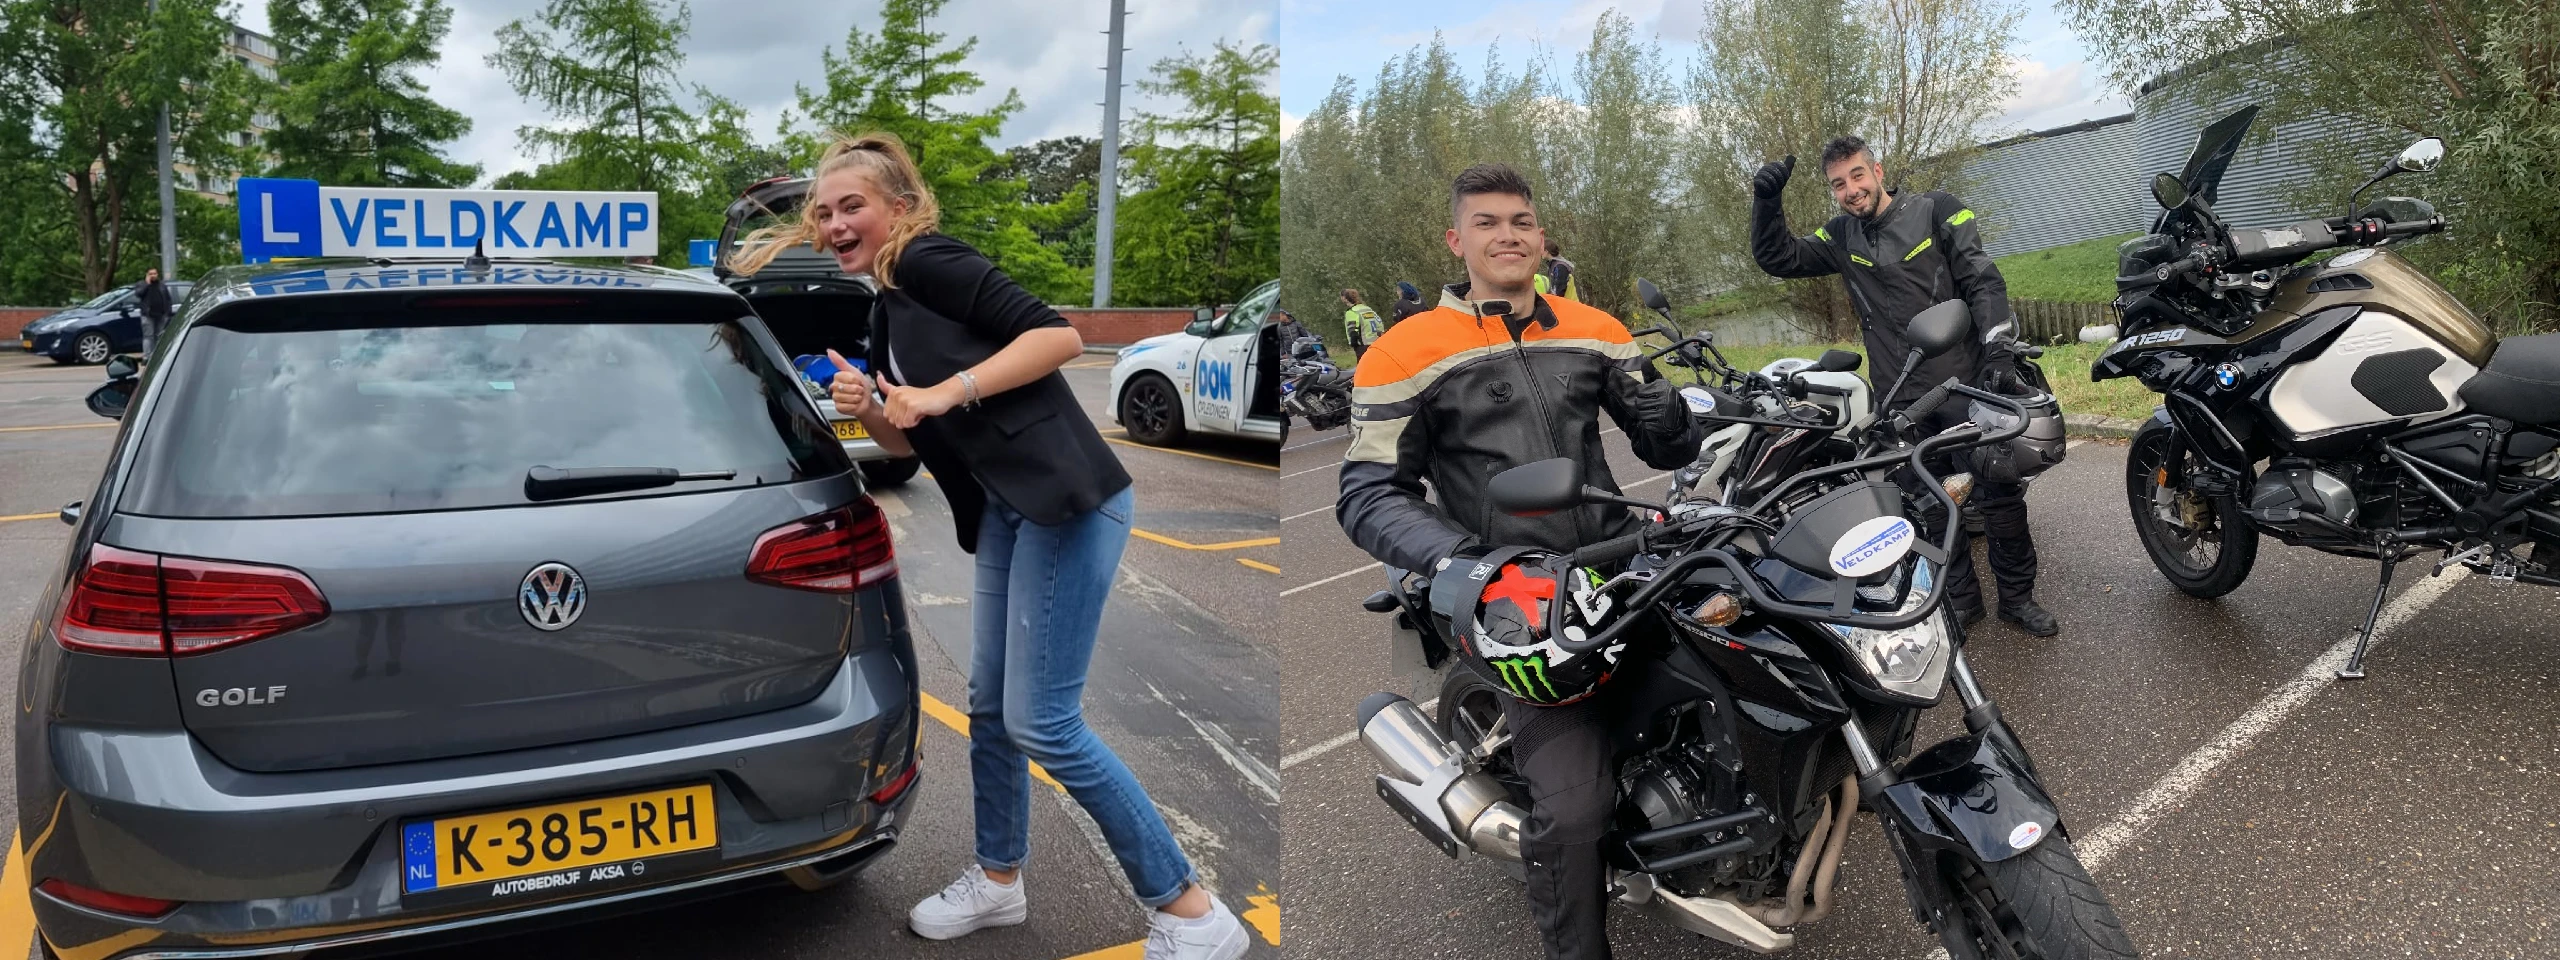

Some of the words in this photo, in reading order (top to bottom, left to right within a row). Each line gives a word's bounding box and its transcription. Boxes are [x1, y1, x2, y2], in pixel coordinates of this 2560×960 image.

[262, 192, 300, 244] L
[329, 197, 649, 249] VELDKAMP
[2138, 328, 2187, 346] 1250
[2336, 330, 2393, 356] GS
[1176, 361, 1187, 370] 26
[1199, 360, 1232, 402] DON
[1835, 528, 1910, 570] VELDKAMP
[195, 684, 288, 707] GOLF
[450, 794, 699, 876] K-385-RH
[409, 864, 433, 881] NL
[491, 870, 582, 898] AUTOBEDRIJF
[588, 863, 626, 883] AKSA
